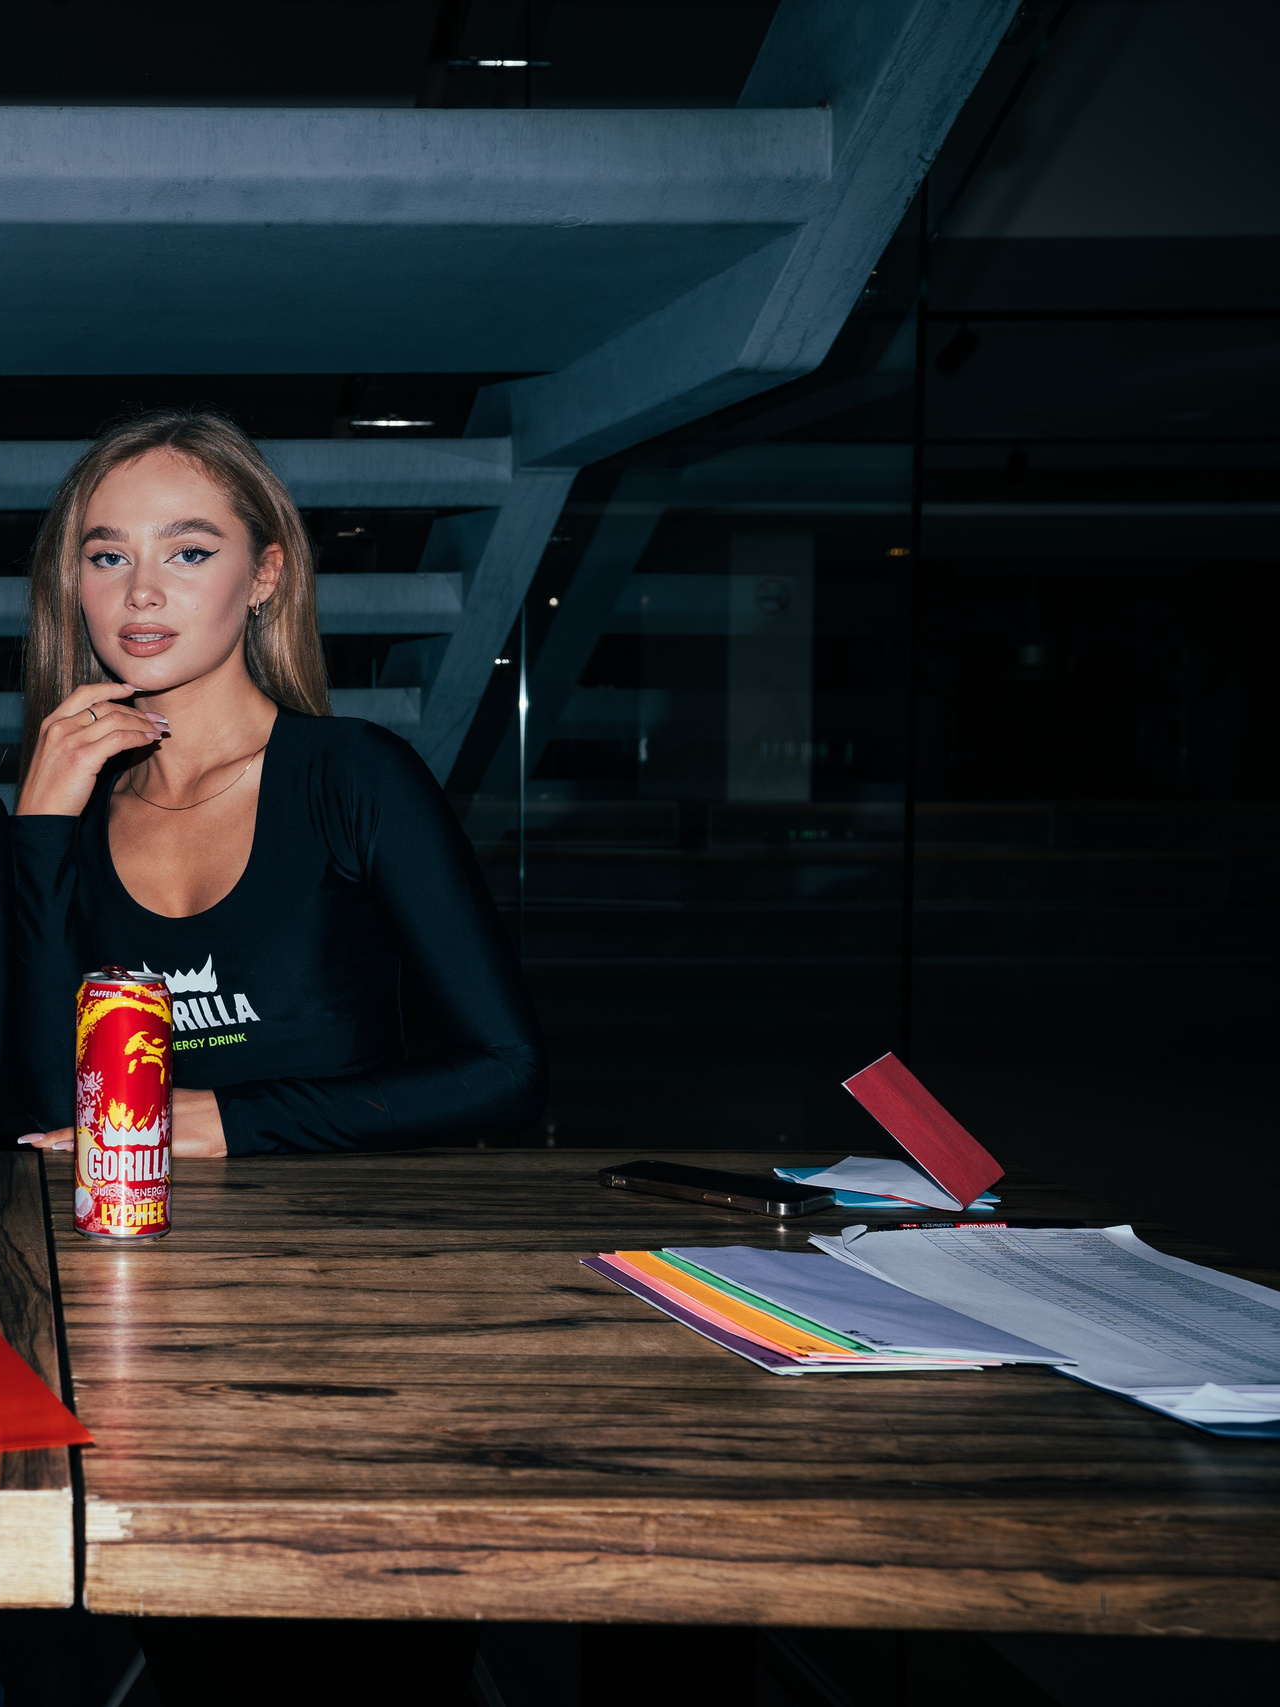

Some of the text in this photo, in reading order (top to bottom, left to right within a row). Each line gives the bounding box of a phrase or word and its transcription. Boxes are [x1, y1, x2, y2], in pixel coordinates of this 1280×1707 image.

[89, 990, 123, 999] CAFFEINE
[172, 993, 261, 1031] RILLA
[172, 1033, 247, 1051] NERGY DRINK
[88, 1147, 170, 1182] GORILLA
[94, 1187, 122, 1198] JUICE
[134, 1185, 166, 1198] ENERGY
[101, 1201, 164, 1226] LYCHEE
